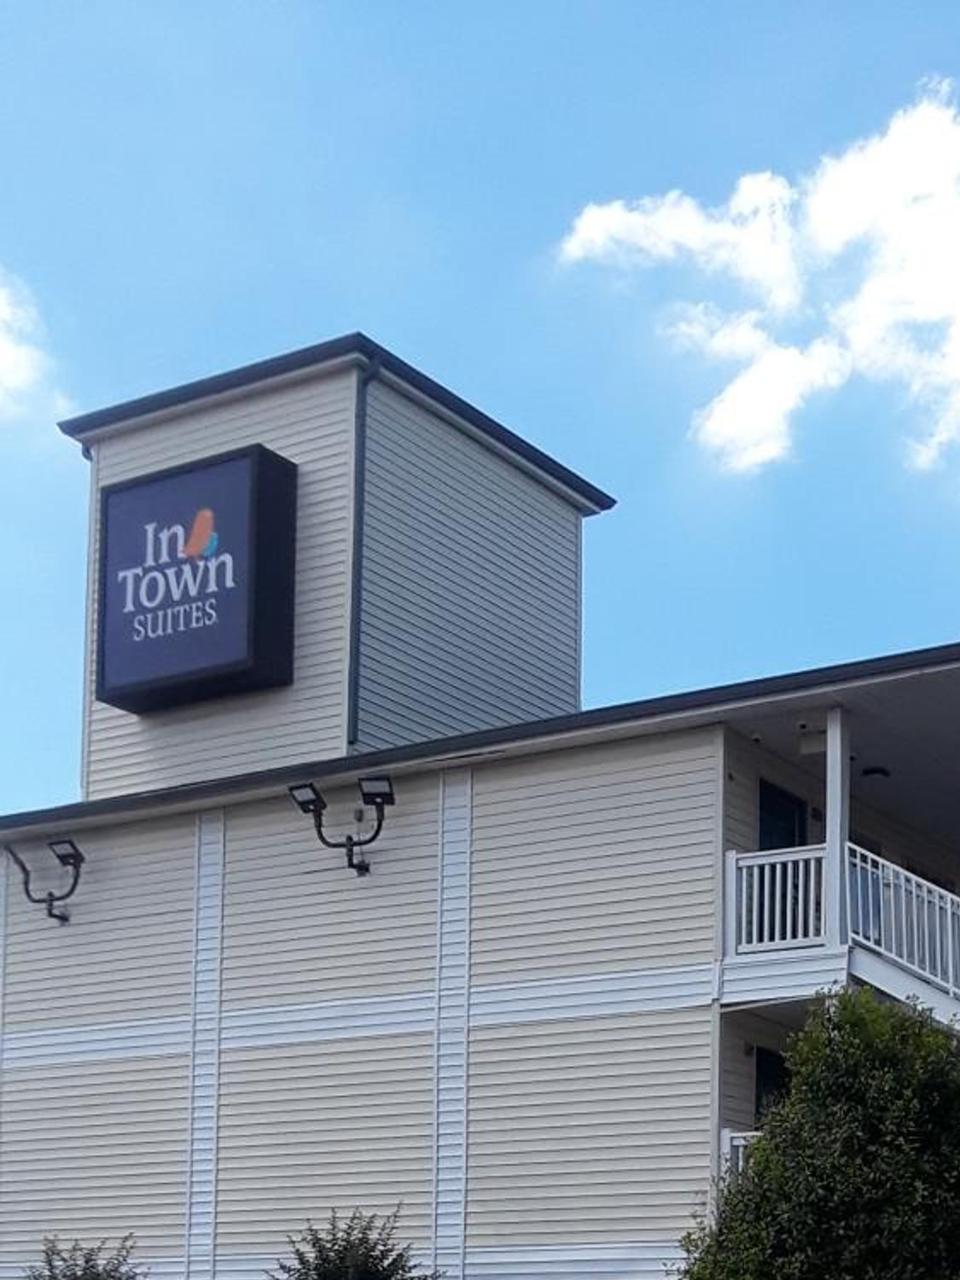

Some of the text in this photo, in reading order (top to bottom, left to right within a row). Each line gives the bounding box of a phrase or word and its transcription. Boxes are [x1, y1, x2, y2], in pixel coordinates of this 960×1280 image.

[143, 522, 187, 567] In
[117, 552, 236, 613] Town
[133, 598, 217, 642] SUITES
